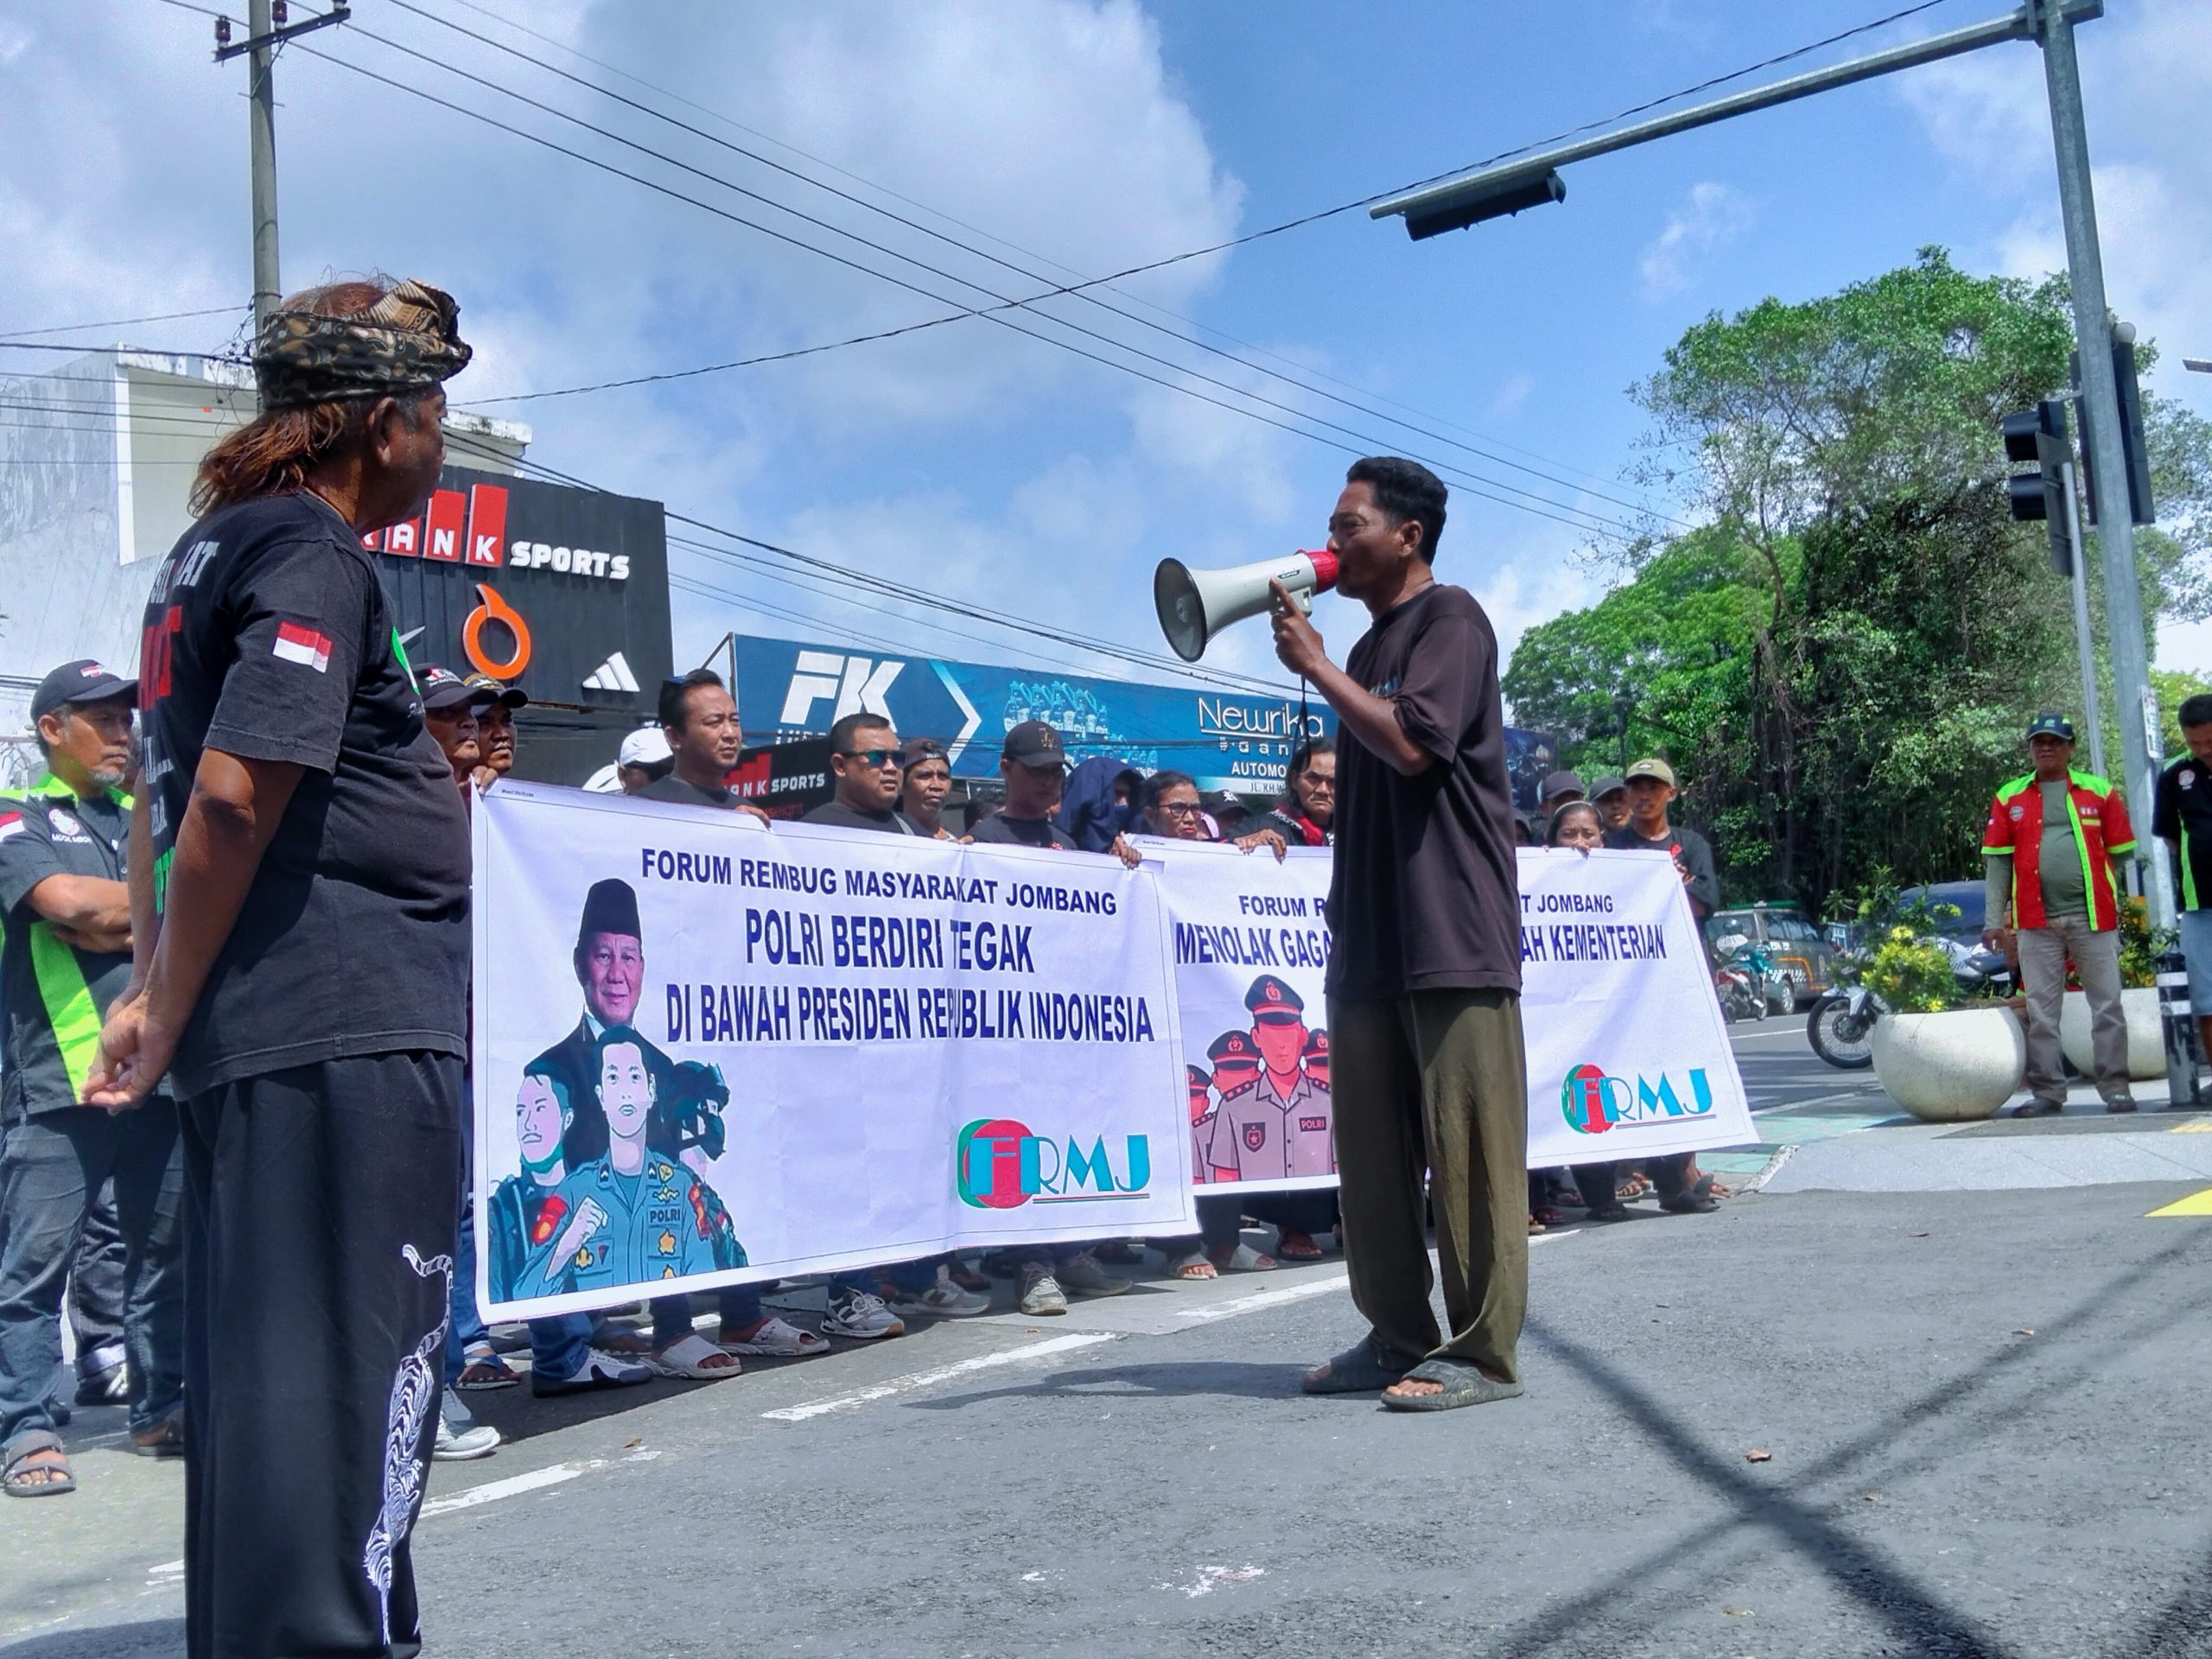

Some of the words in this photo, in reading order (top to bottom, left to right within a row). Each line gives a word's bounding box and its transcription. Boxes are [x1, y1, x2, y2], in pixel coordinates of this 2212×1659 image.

[510, 540, 630, 580] SPORTS
[780, 650, 906, 734] FK
[1198, 697, 1324, 737] Newrika
[771, 772, 825, 792] SPORTS
[1231, 761, 1287, 778] AUTOMO
[642, 848, 732, 885] FORUM
[741, 858, 837, 894] REMBUG
[845, 869, 998, 905] MASYARAKAT
[1006, 882, 1116, 916] JOMBANG
[1238, 895, 1307, 917] FORUM
[1537, 894, 1613, 912] JOMBANG
[746, 908, 824, 967] POLRI
[831, 915, 944, 968] BERDIRI
[950, 918, 1035, 973] TEGAK
[1176, 922, 1280, 967] MENOLAK
[1549, 925, 1667, 961] KEMENTERIAN
[666, 983, 691, 1042] DI
[701, 984, 791, 1042] BAWAH
[798, 987, 912, 1041] PRESIDEN
[918, 988, 1025, 1039] REPUBLIK
[1028, 991, 1155, 1042] INDONESIA
[1300, 1119, 1325, 1129] POLRI
[969, 1133, 1151, 1196] FRMJ
[650, 1209, 681, 1224] POLRI
